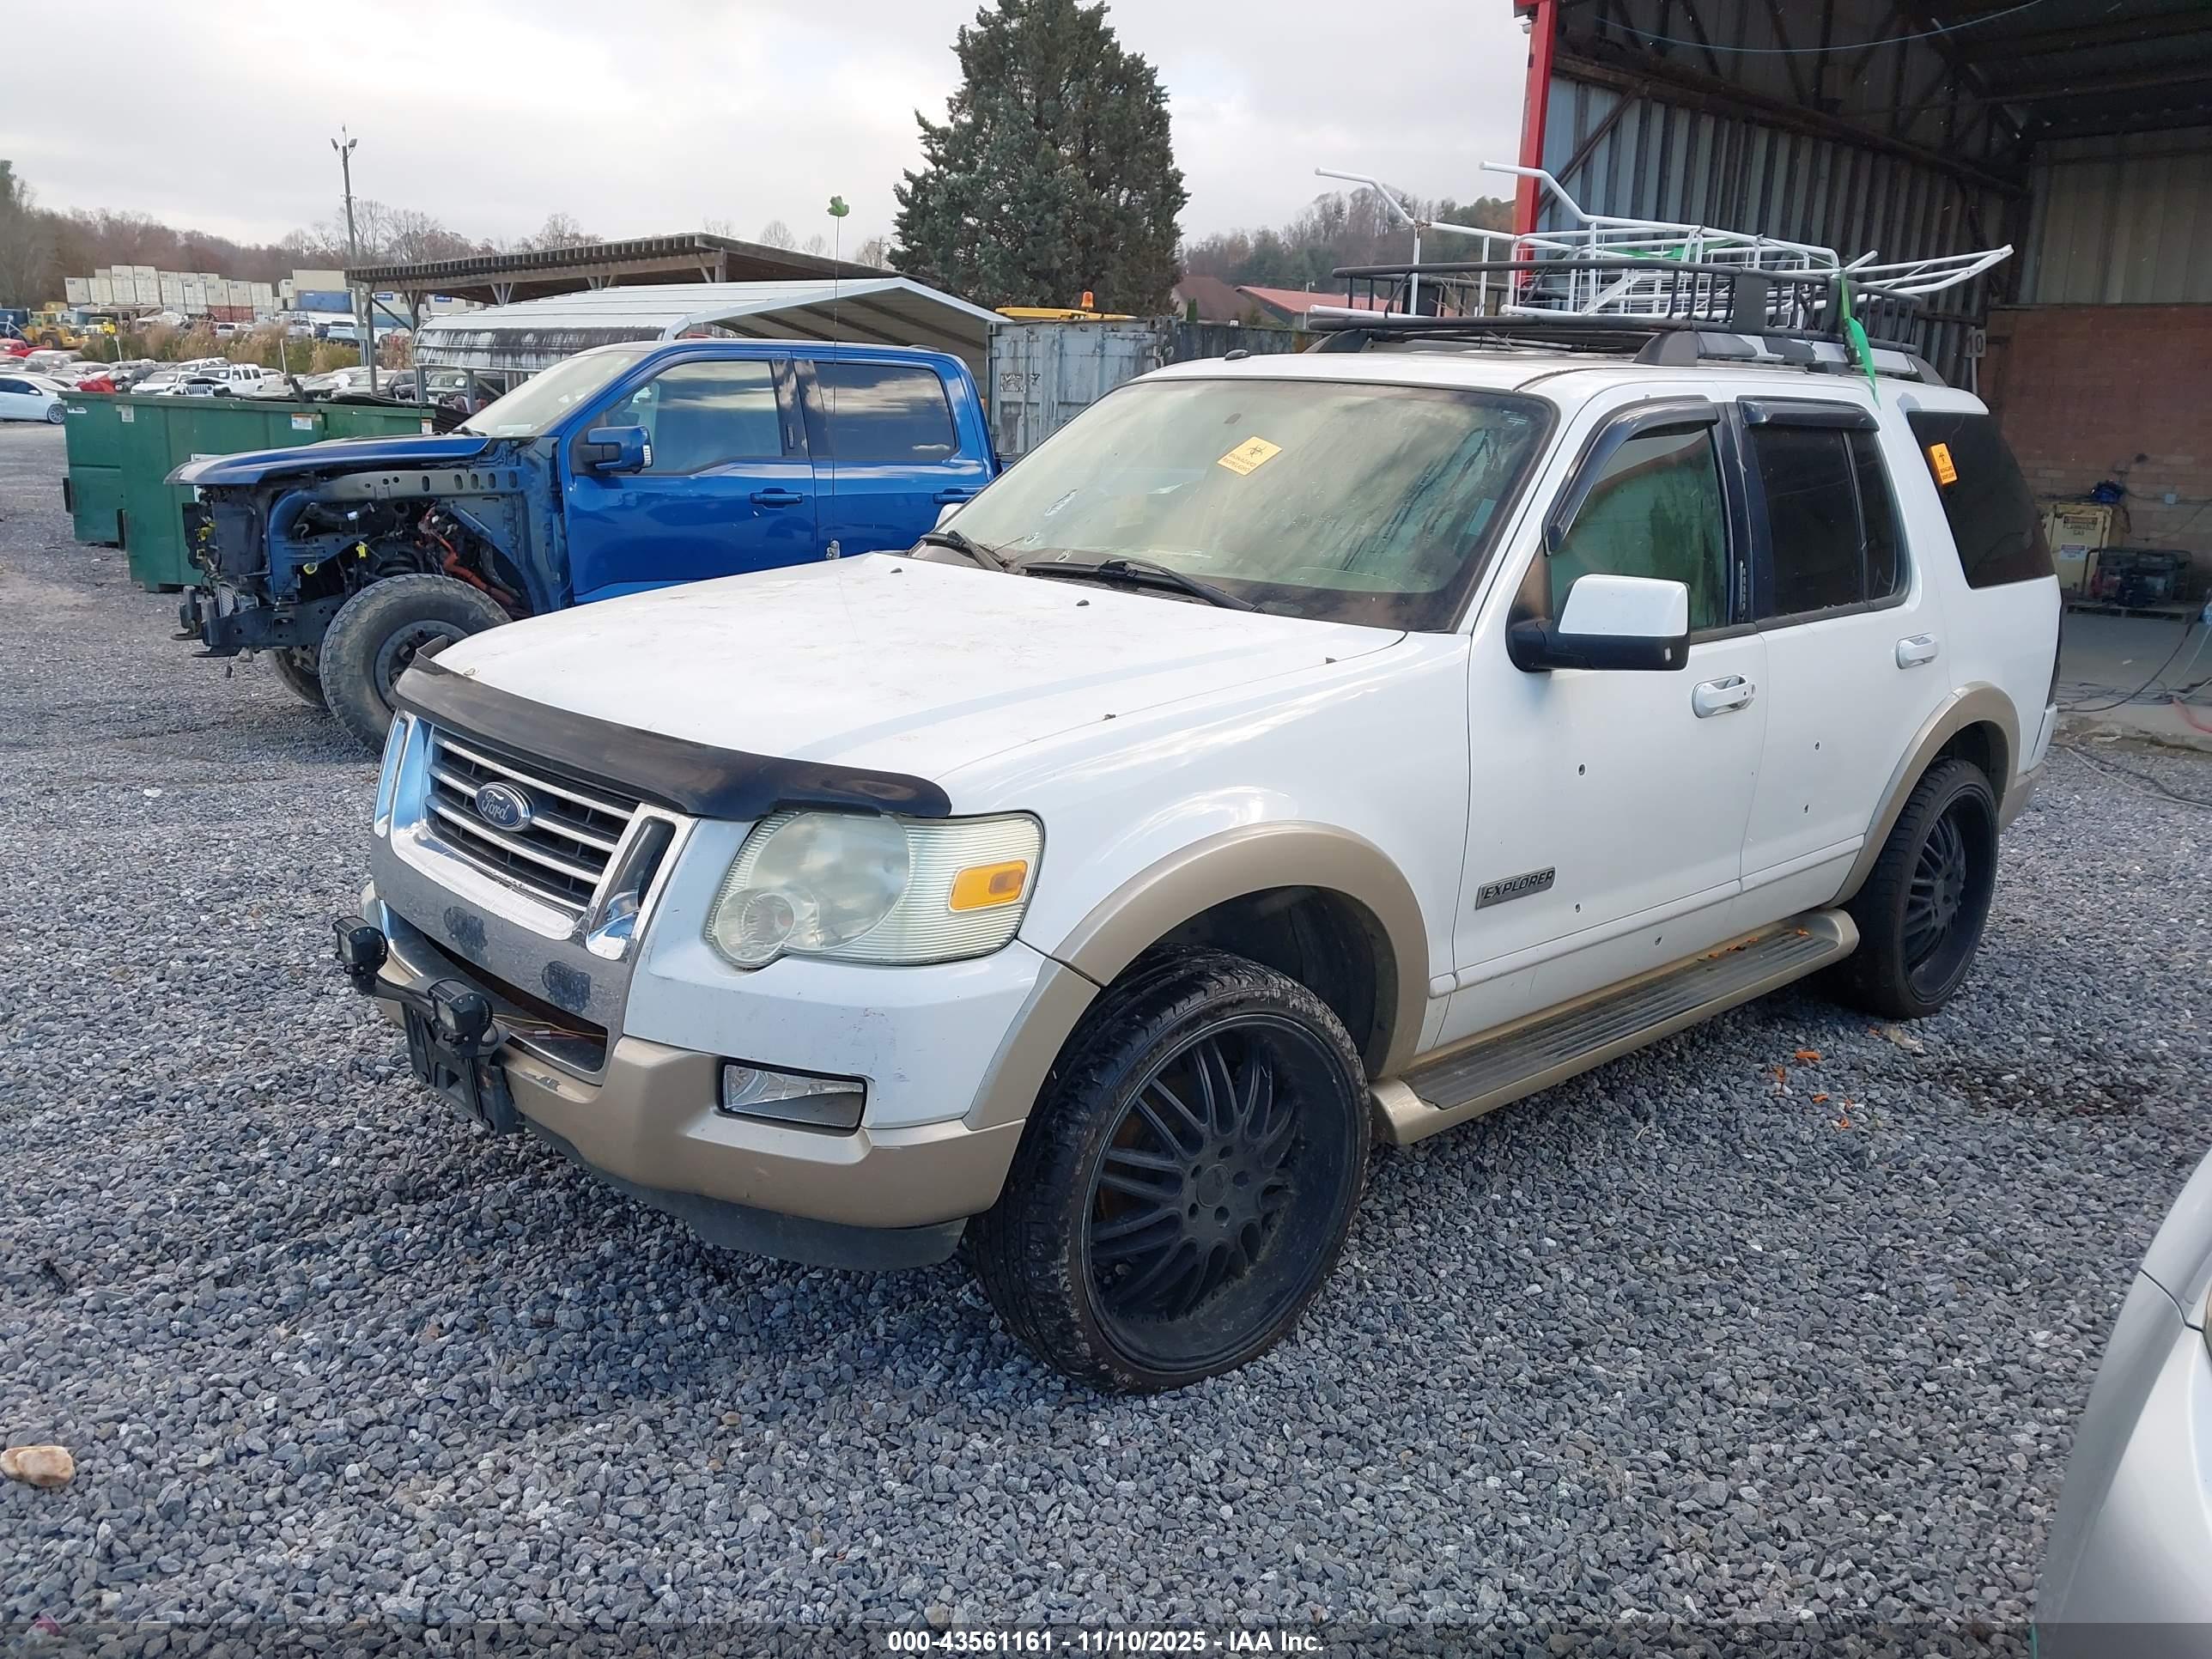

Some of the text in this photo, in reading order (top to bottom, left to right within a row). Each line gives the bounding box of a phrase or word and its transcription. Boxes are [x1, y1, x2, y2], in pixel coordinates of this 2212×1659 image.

[1969, 334, 1984, 353] 10
[482, 790, 511, 820] Ford
[1483, 870, 1555, 900] EXPLORER
